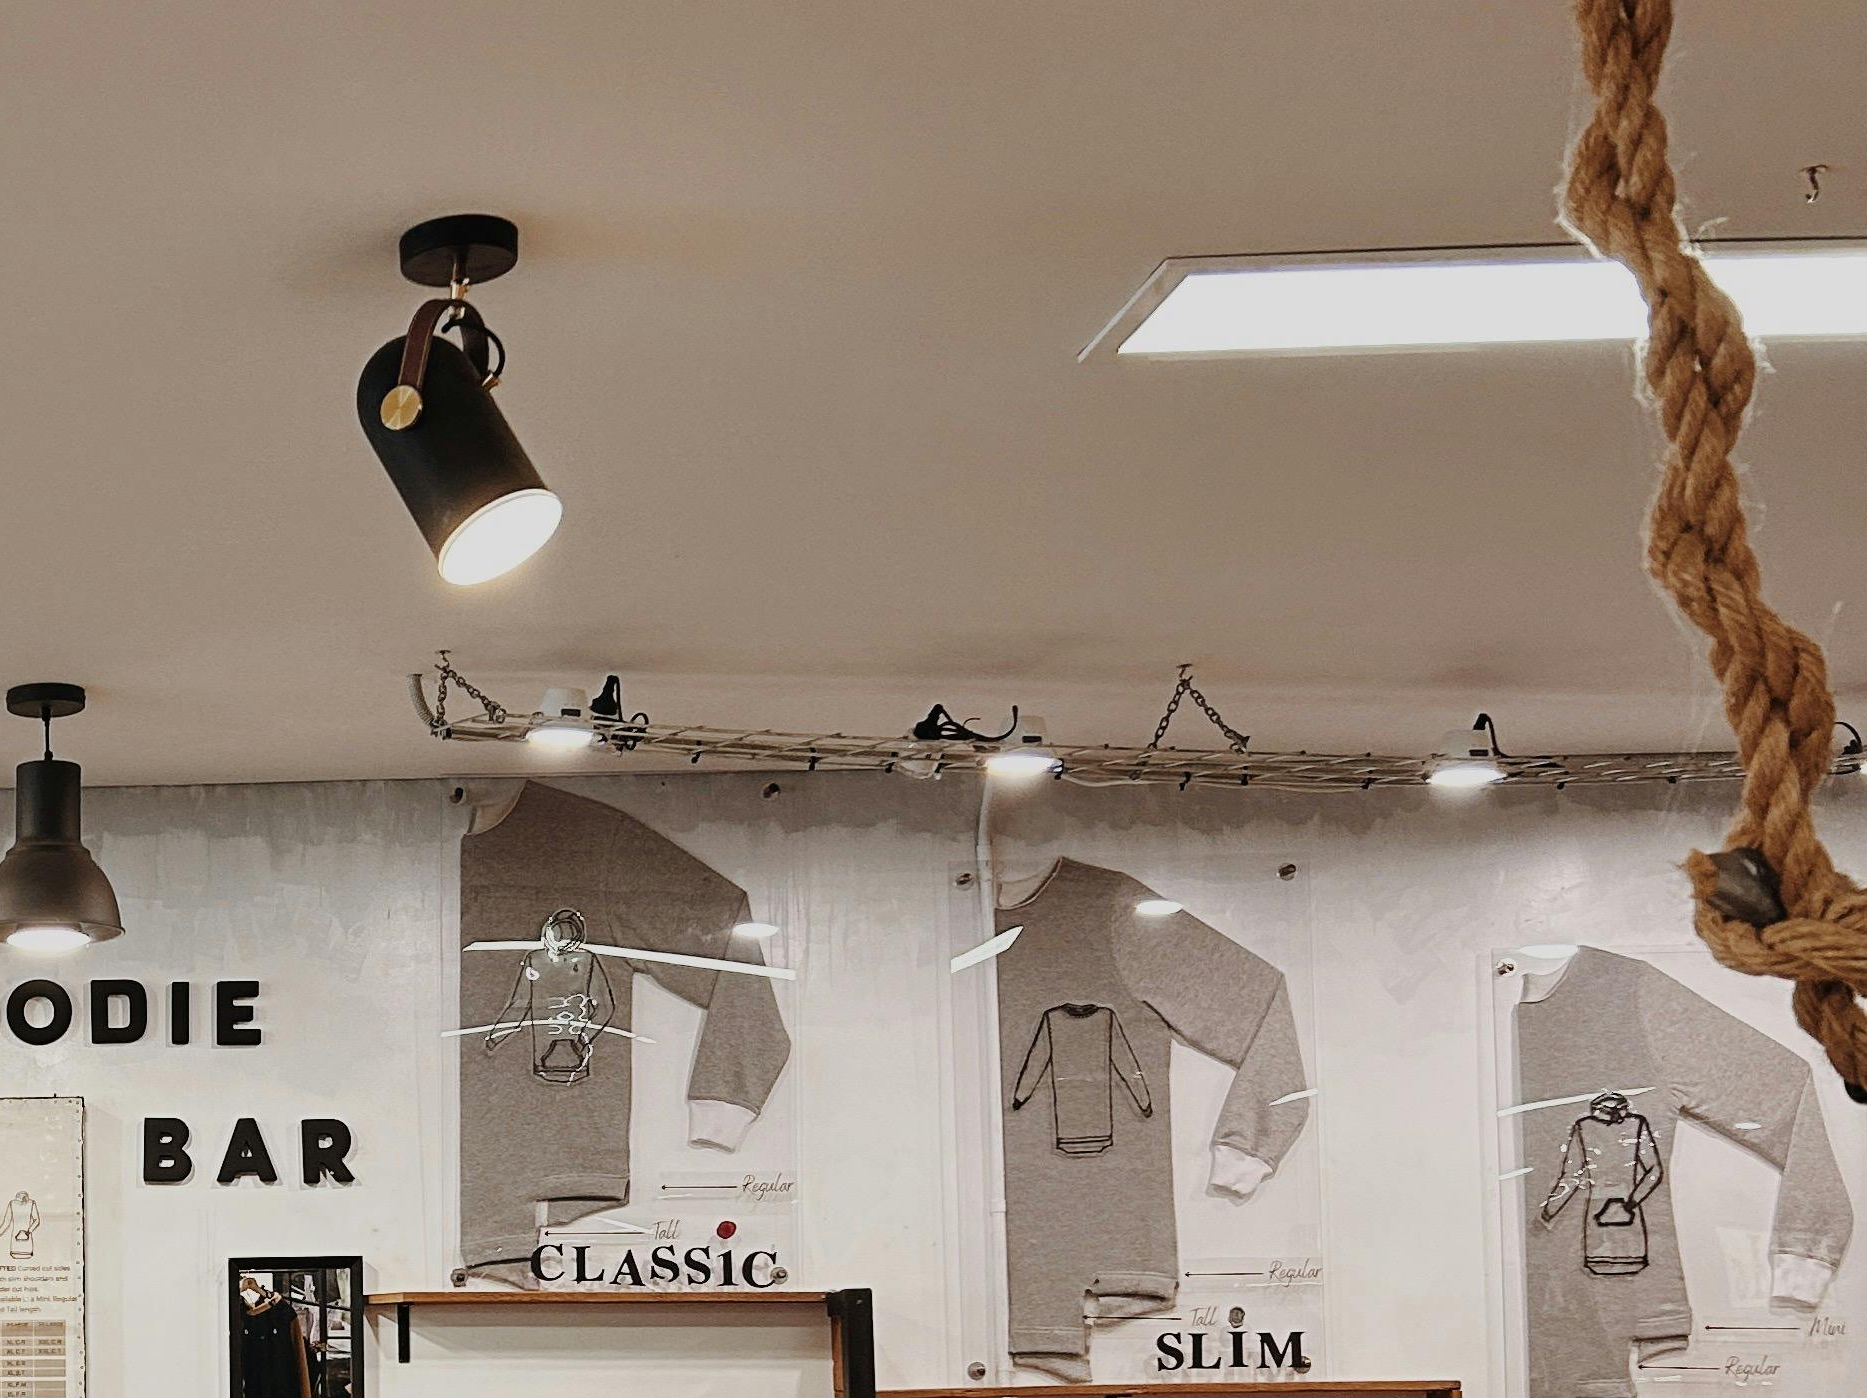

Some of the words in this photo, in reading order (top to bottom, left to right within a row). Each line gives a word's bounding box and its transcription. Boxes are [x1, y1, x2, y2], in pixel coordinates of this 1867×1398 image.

[142, 1116, 356, 1186] BAR
[741, 1172, 794, 1201] Regular
[653, 1219, 682, 1241] Tall
[1269, 1258, 1323, 1288] Regular
[1190, 1306, 1219, 1327] Tall
[1156, 1331, 1306, 1371] SLIM
[1725, 1355, 1781, 1381] Regular
